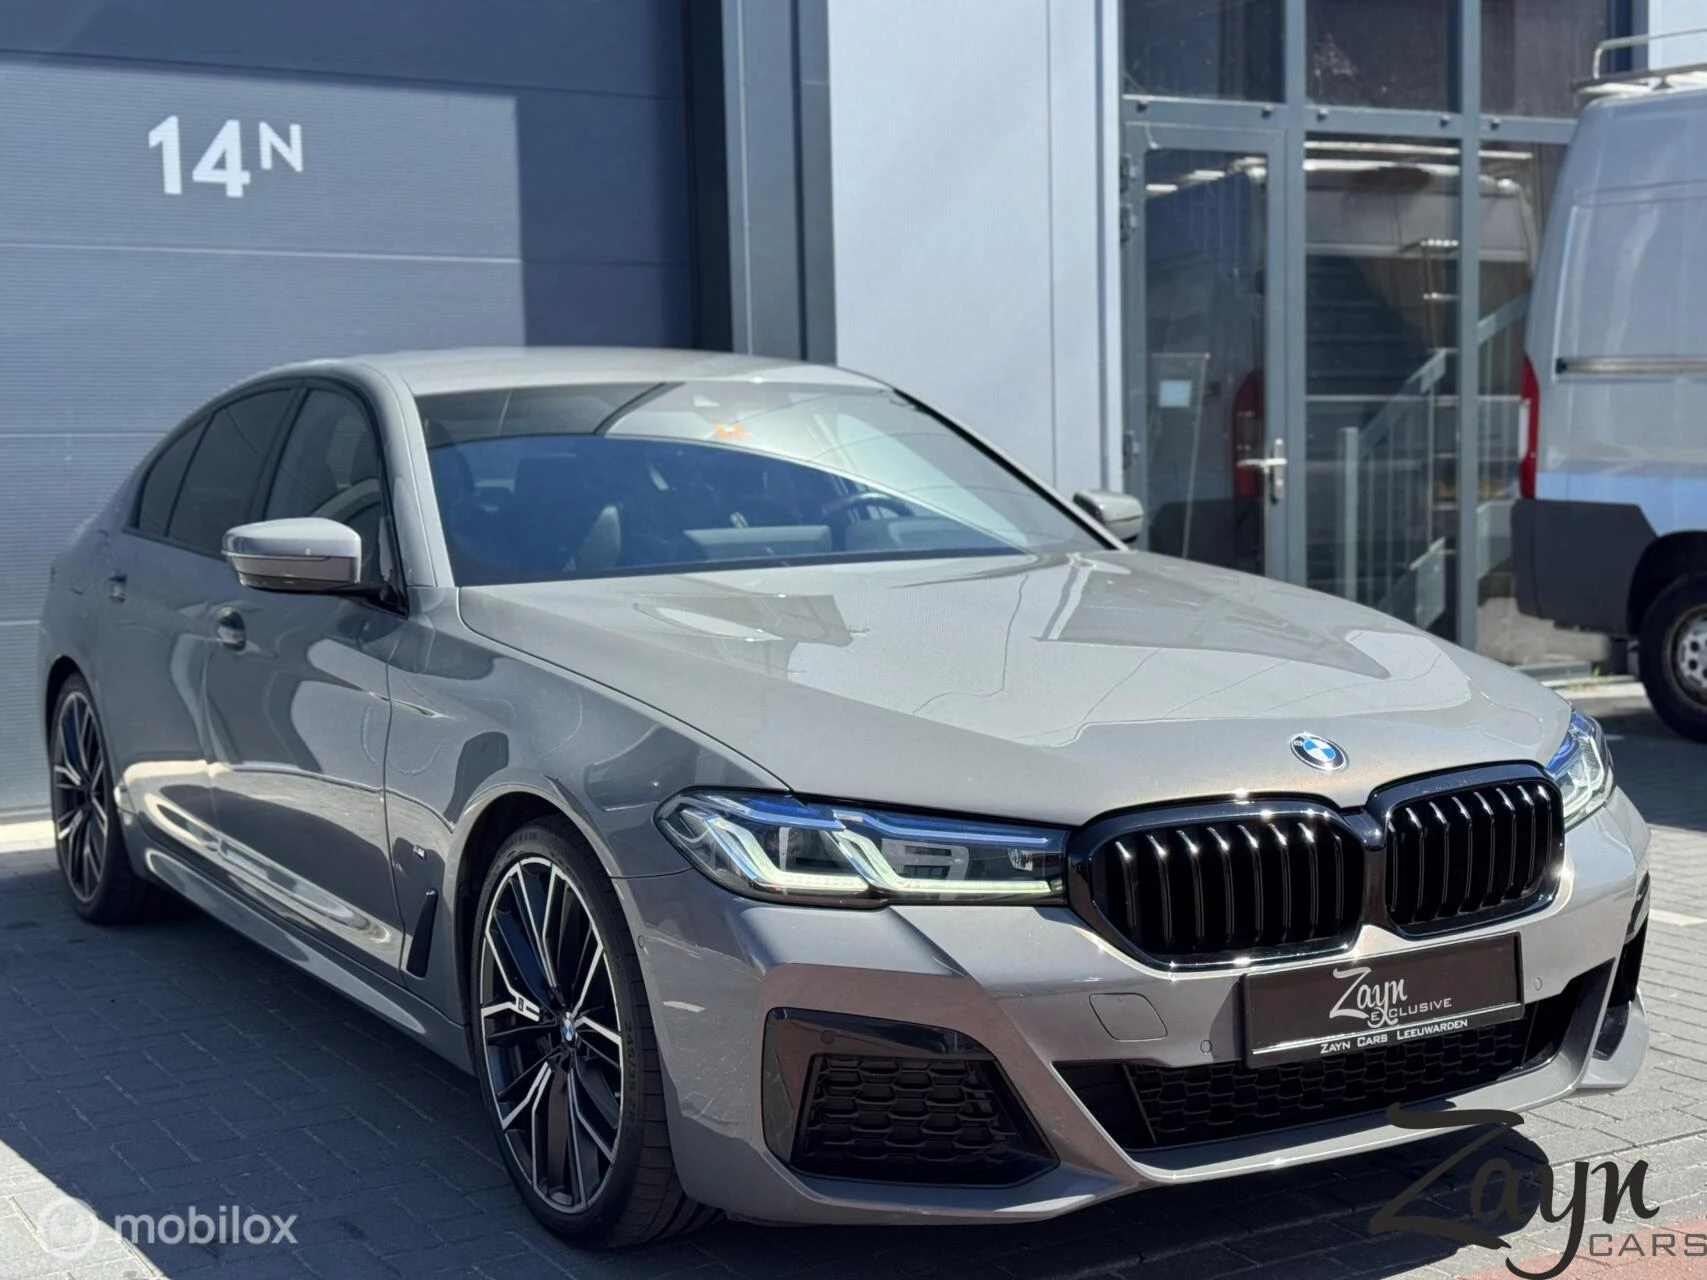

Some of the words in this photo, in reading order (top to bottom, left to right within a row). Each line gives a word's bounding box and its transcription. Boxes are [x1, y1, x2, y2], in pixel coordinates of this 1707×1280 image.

[1329, 966, 1408, 1028] Zayn
[1367, 998, 1452, 1028] EXCLUSIVE
[1320, 1041, 1350, 1054] ZAYN
[1357, 1033, 1388, 1047] CARS
[1397, 1019, 1468, 1040] LEEUWARDEN
